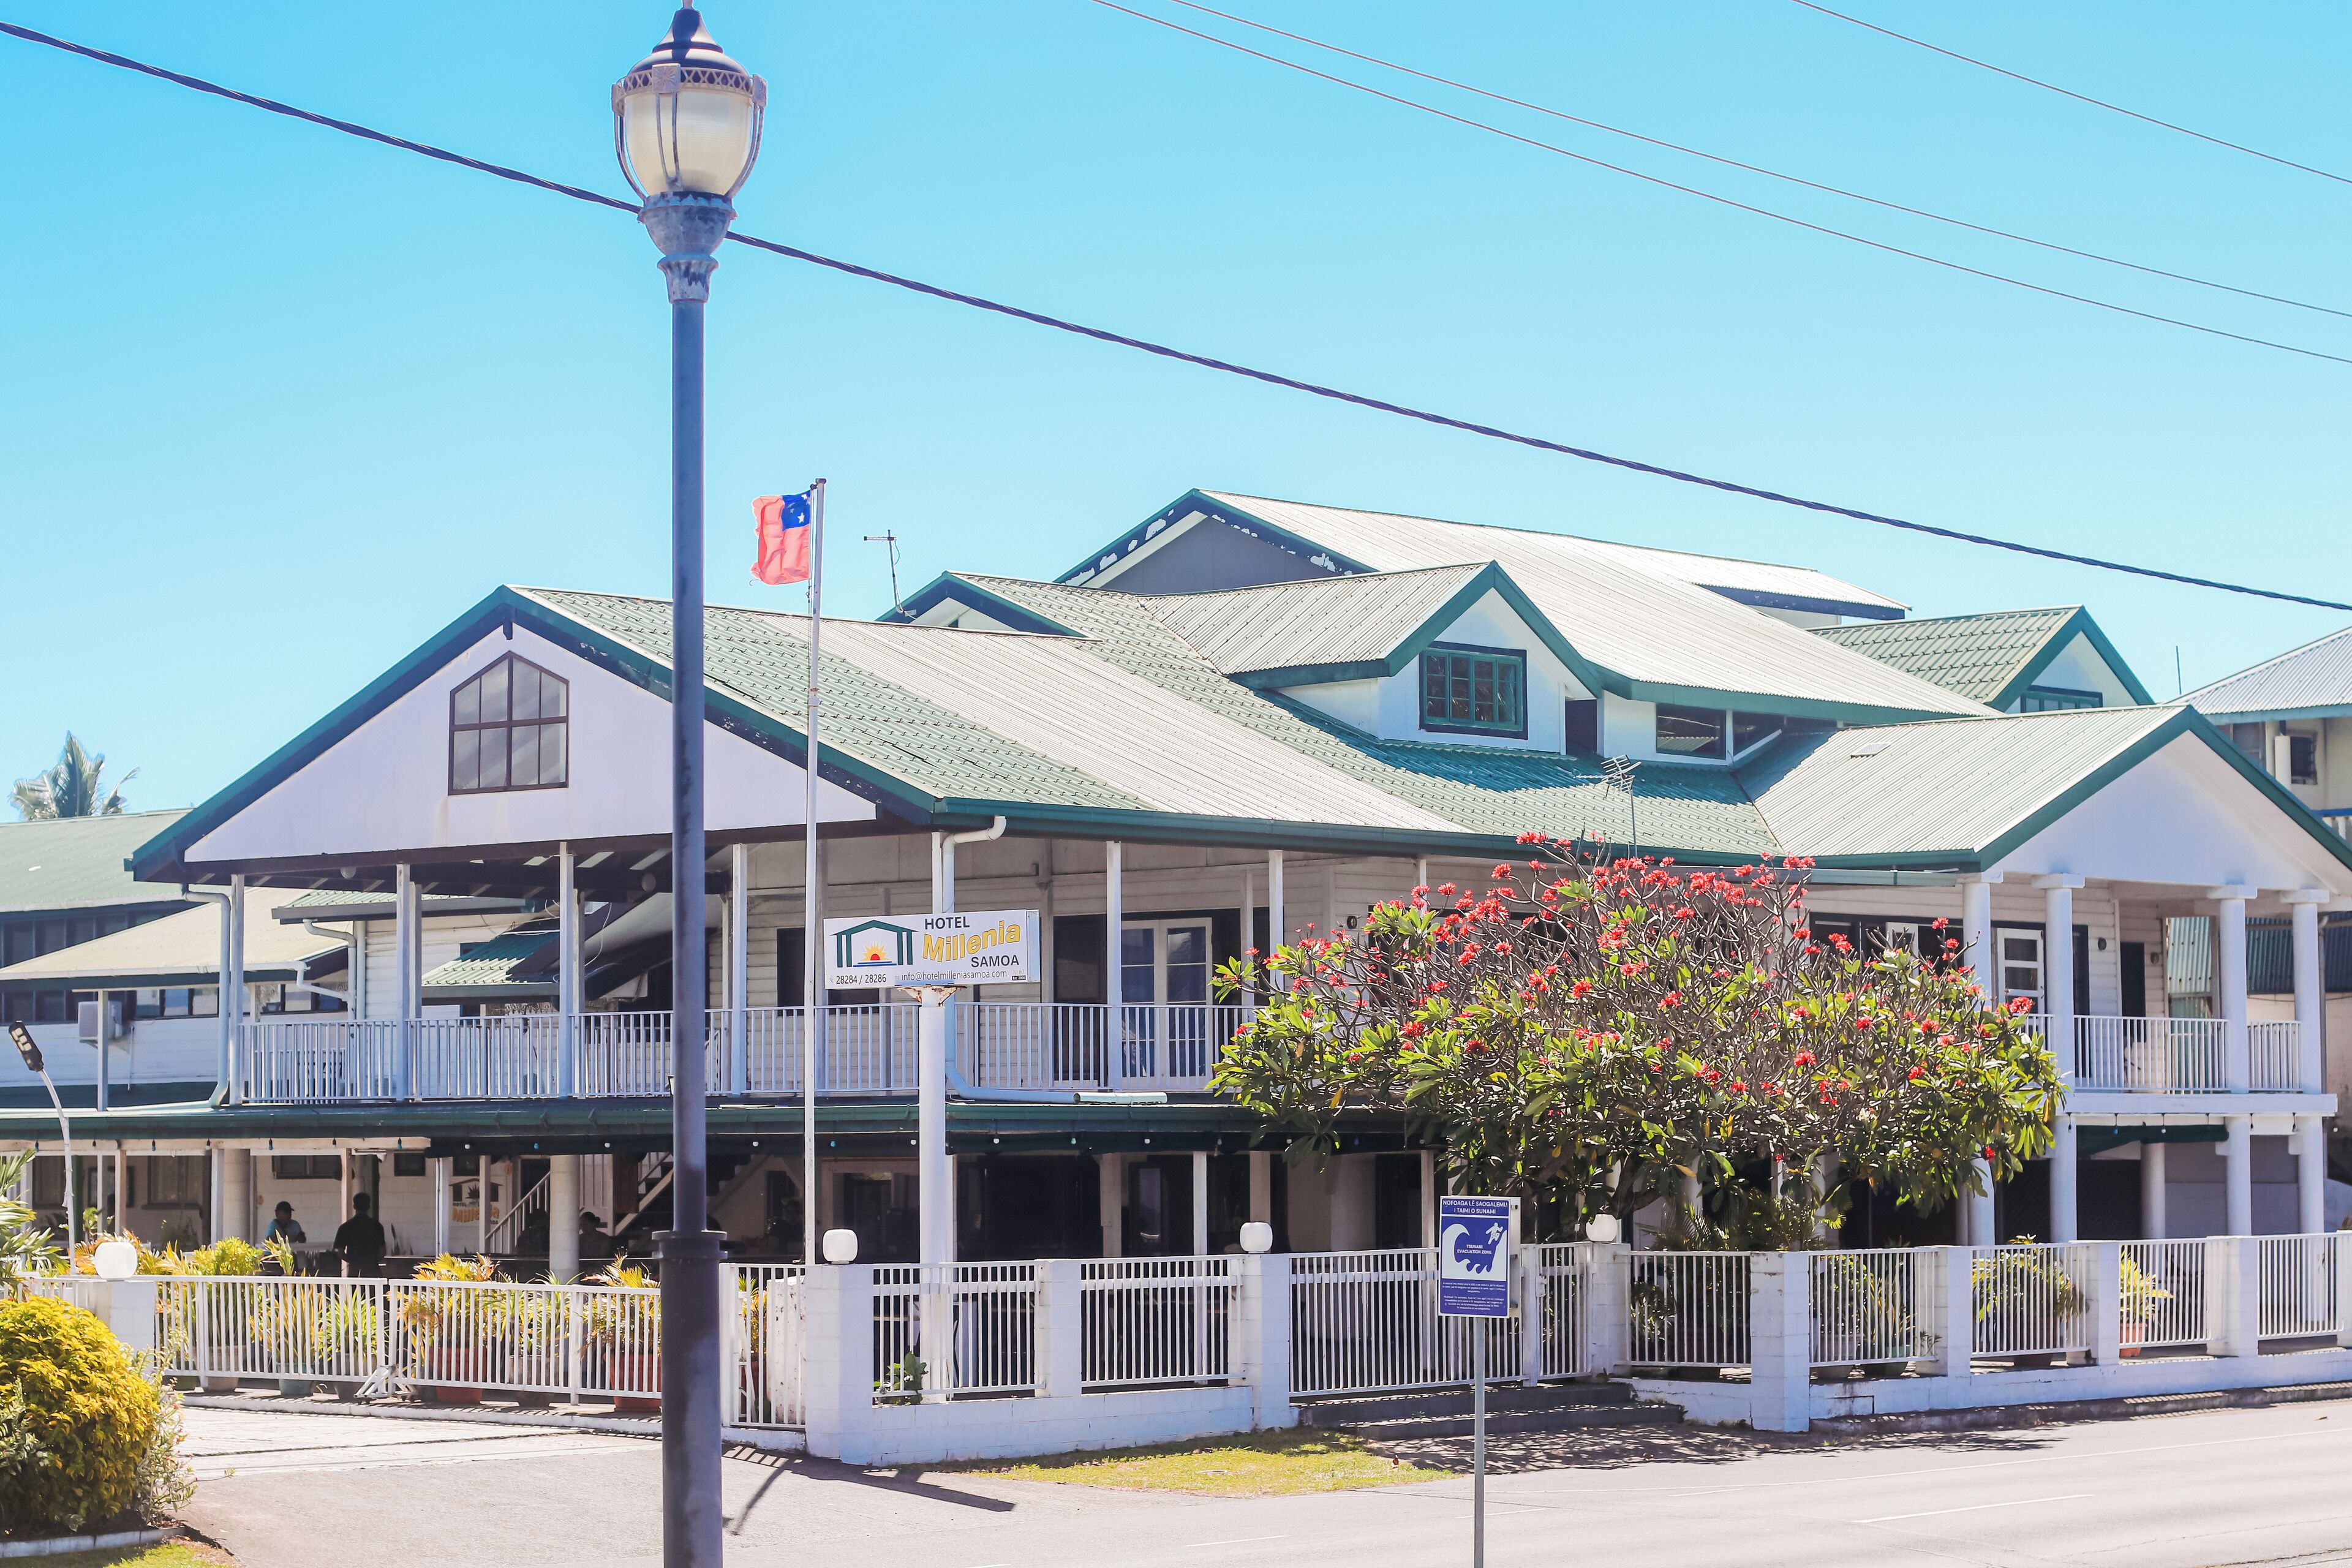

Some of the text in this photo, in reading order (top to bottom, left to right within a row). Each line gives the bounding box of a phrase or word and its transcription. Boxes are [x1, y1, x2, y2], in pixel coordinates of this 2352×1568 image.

[925, 916, 970, 930] HOTEL
[922, 920, 1021, 962] Millenia
[971, 954, 1019, 968] SAMOA
[836, 974, 886, 984] 28284 / 28286
[902, 970, 1007, 981] info@hotelmilleniasamoa.com
